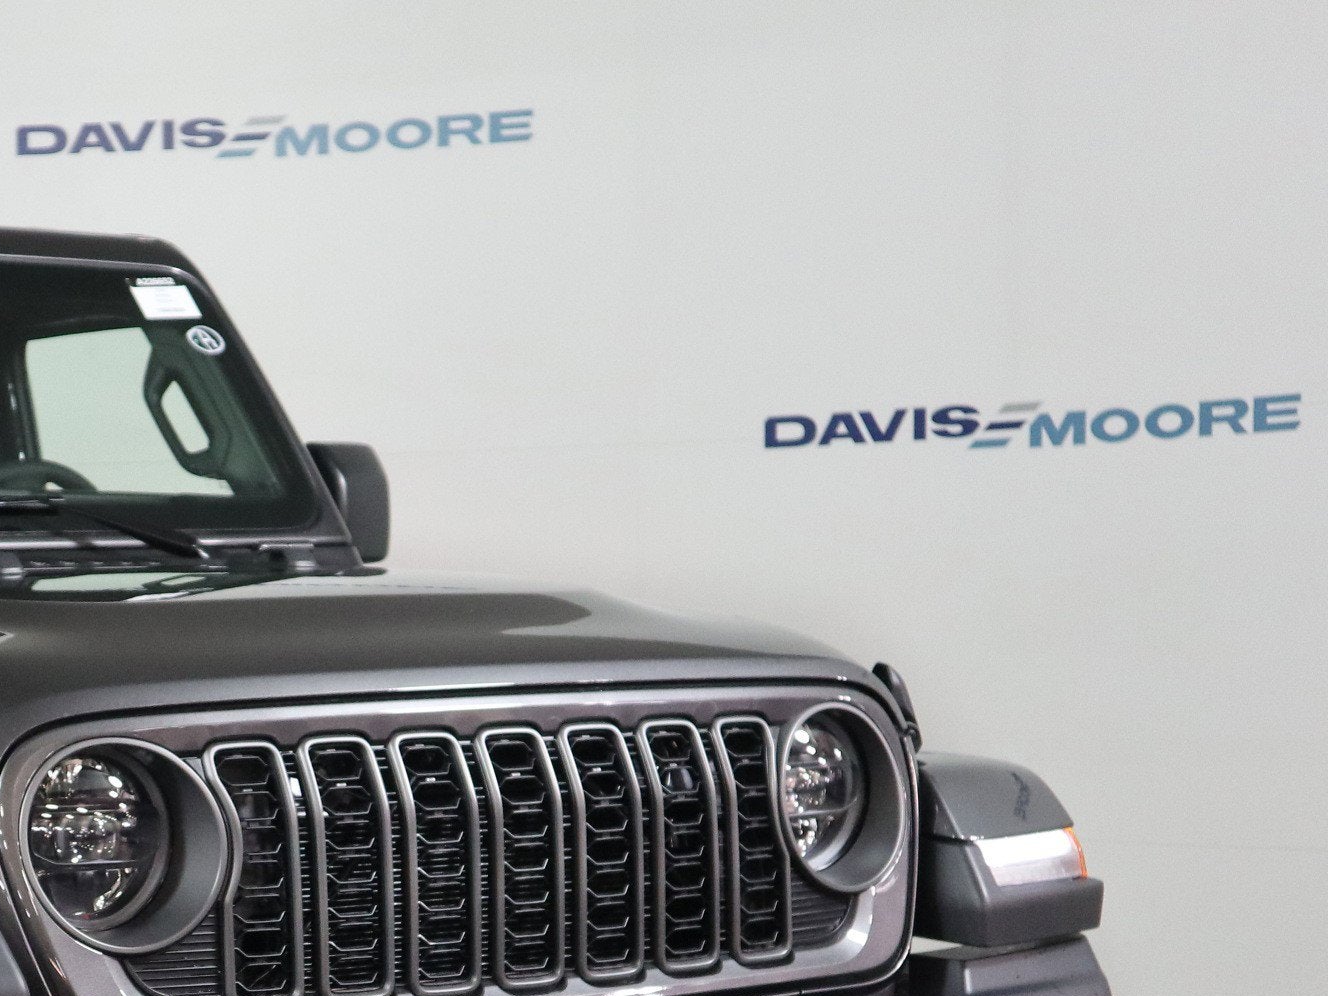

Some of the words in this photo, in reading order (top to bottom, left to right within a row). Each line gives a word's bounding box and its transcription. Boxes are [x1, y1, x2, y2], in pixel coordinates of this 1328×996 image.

[15, 118, 226, 156] DAVIS
[274, 109, 534, 158] MOORE
[764, 405, 979, 449] DAVIS
[1029, 393, 1302, 448] MOORE
